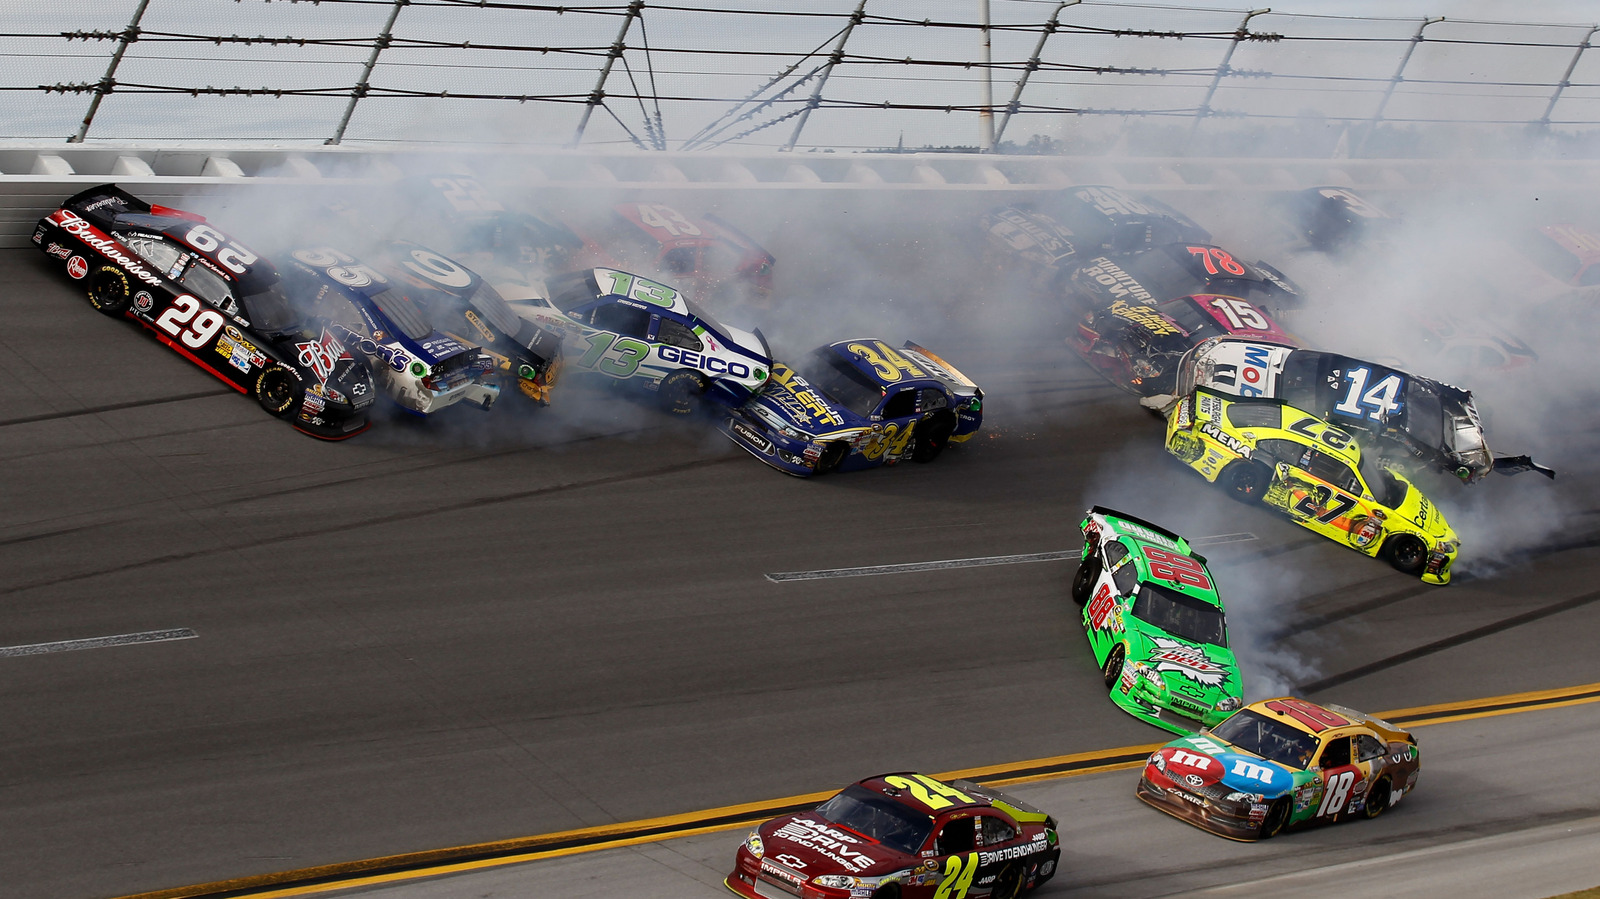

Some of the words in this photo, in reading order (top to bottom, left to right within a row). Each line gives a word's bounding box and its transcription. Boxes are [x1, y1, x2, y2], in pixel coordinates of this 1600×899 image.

[638, 204, 701, 236] 43
[60, 209, 163, 287] Budweiser
[185, 224, 258, 274] 29
[1186, 246, 1245, 276] 78
[102, 265, 130, 296] GOODYEAR
[400, 250, 471, 288] 9
[1082, 265, 1130, 298] ROW
[1090, 256, 1158, 306] FURNITURE
[609, 272, 678, 309] 13
[154, 294, 225, 348] 29
[467, 311, 493, 340] STANLEY
[1211, 298, 1269, 330] 15
[251, 355, 265, 367] 3M
[298, 336, 346, 379] Bud
[577, 332, 651, 380] 13
[658, 344, 750, 379] GEICO
[848, 340, 928, 383] 34
[1240, 346, 1269, 397] Mob
[772, 363, 838, 427] ALERT
[1335, 366, 1403, 424] 14
[734, 424, 766, 447] FUSION
[868, 419, 917, 460] 34
[1200, 423, 1253, 460] MENA
[1288, 417, 1353, 451] 27
[1293, 484, 1358, 525] 27
[1362, 531, 1374, 540] 3M
[1142, 546, 1212, 590] 88
[1088, 584, 1115, 632] 88
[1161, 652, 1217, 671] Dew
[1171, 697, 1209, 713] IMPALA
[1264, 699, 1351, 734] 18
[1169, 750, 1212, 770] m
[1185, 737, 1226, 754] m
[1231, 759, 1274, 784] m
[884, 774, 976, 810] 24
[1166, 787, 1210, 808] CAMRY
[1316, 771, 1356, 817] 18
[779, 822, 876, 869] DRIVE
[792, 817, 860, 844] AARP
[773, 831, 789, 839] TO
[787, 836, 814, 848] END
[812, 844, 861, 874] HUNGER
[979, 848, 1004, 867] DRIVE
[1004, 849, 1013, 859] TO
[1012, 845, 1029, 859] END
[1026, 840, 1048, 856] HUNGER
[760, 862, 802, 885] IMPALA
[933, 852, 979, 899] 24
[978, 875, 996, 885] AARP
